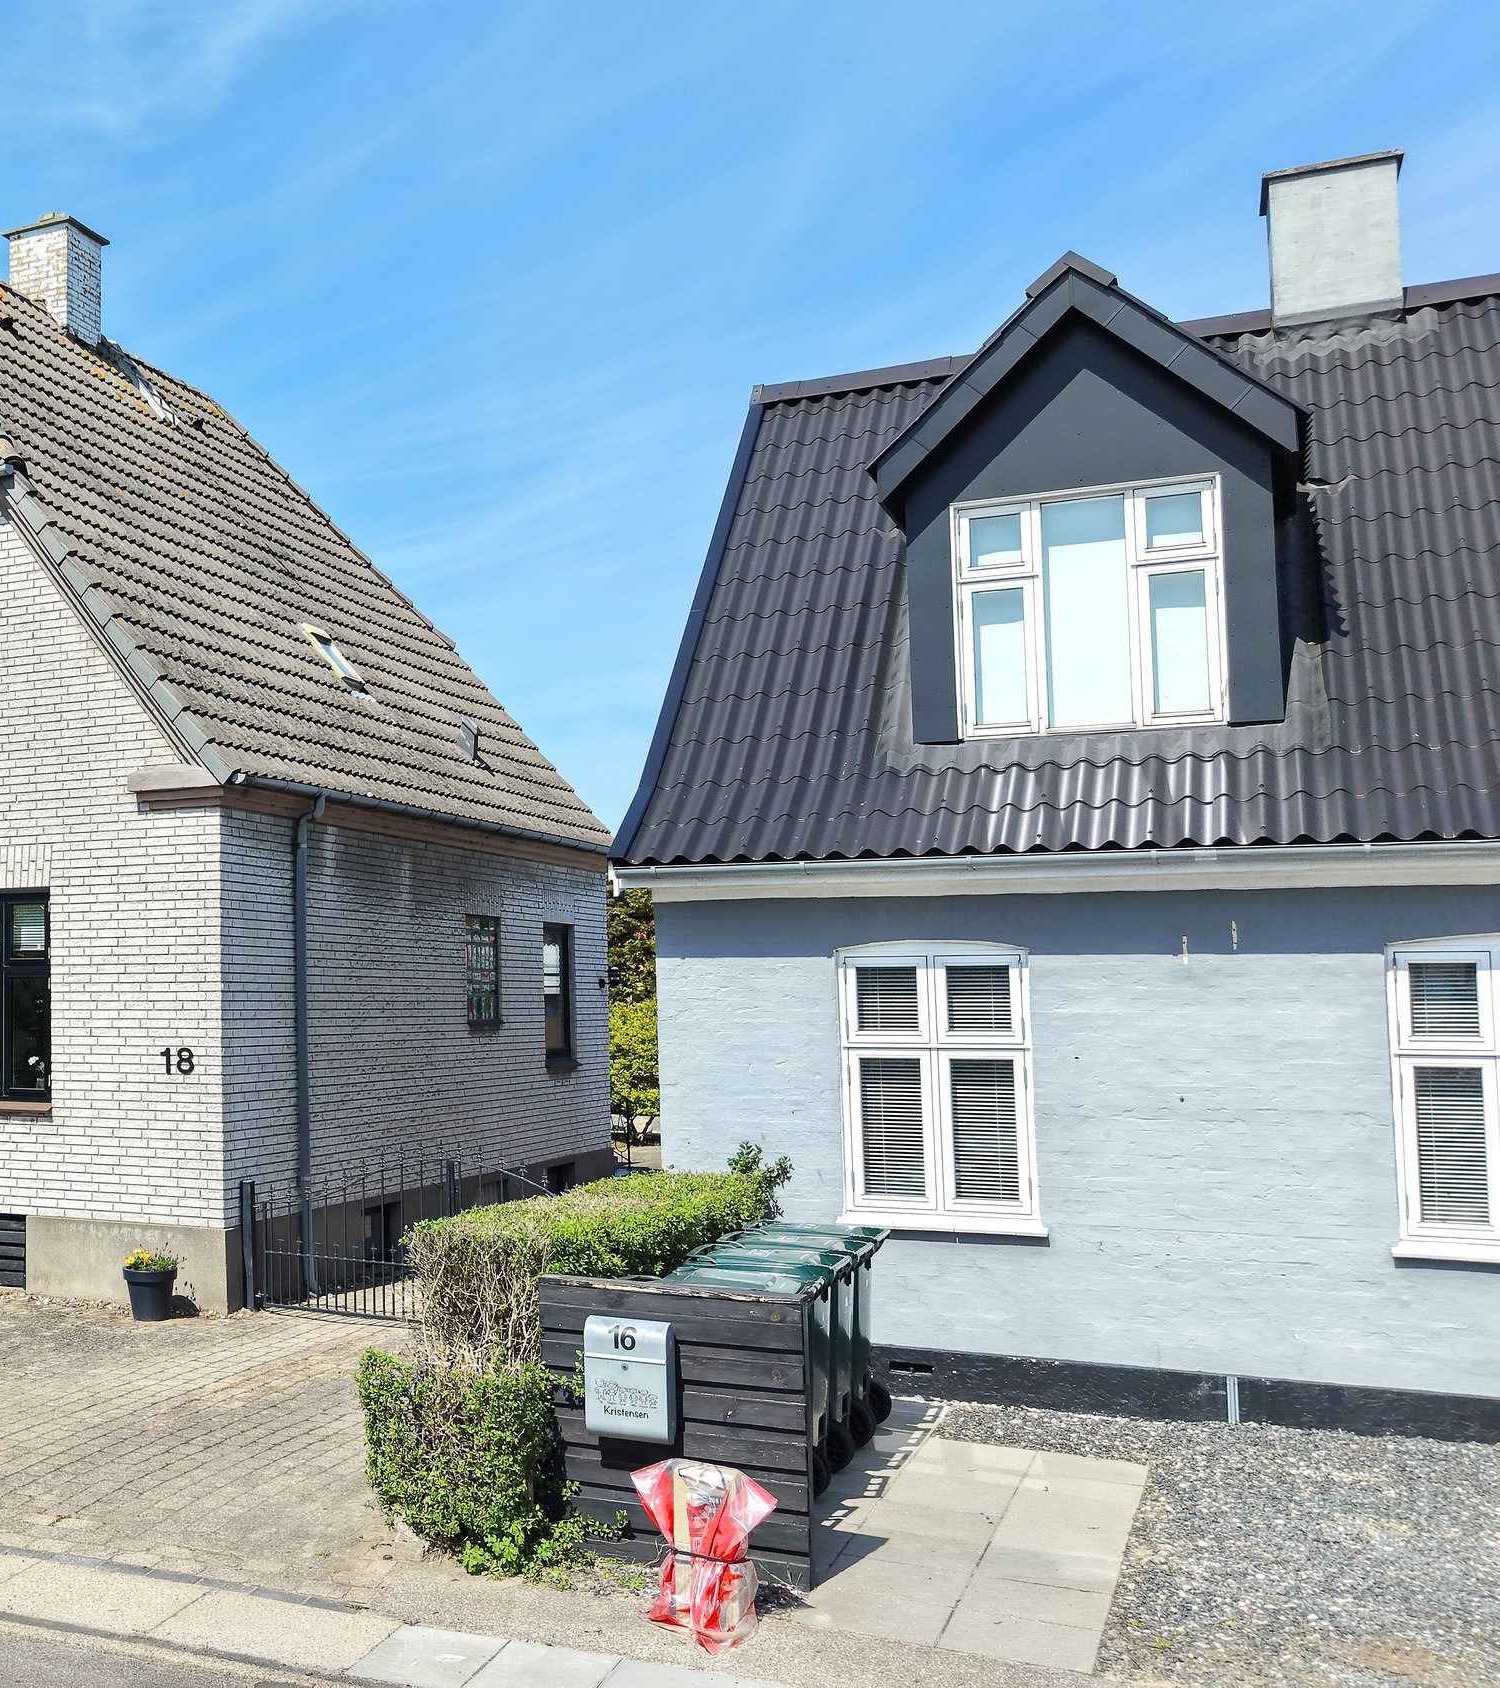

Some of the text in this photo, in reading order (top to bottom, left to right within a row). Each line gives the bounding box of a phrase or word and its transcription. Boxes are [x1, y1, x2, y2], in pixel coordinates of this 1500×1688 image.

[160, 1047, 195, 1075] 18
[608, 1325, 637, 1351] 16
[603, 1405, 649, 1419] Kristensen
